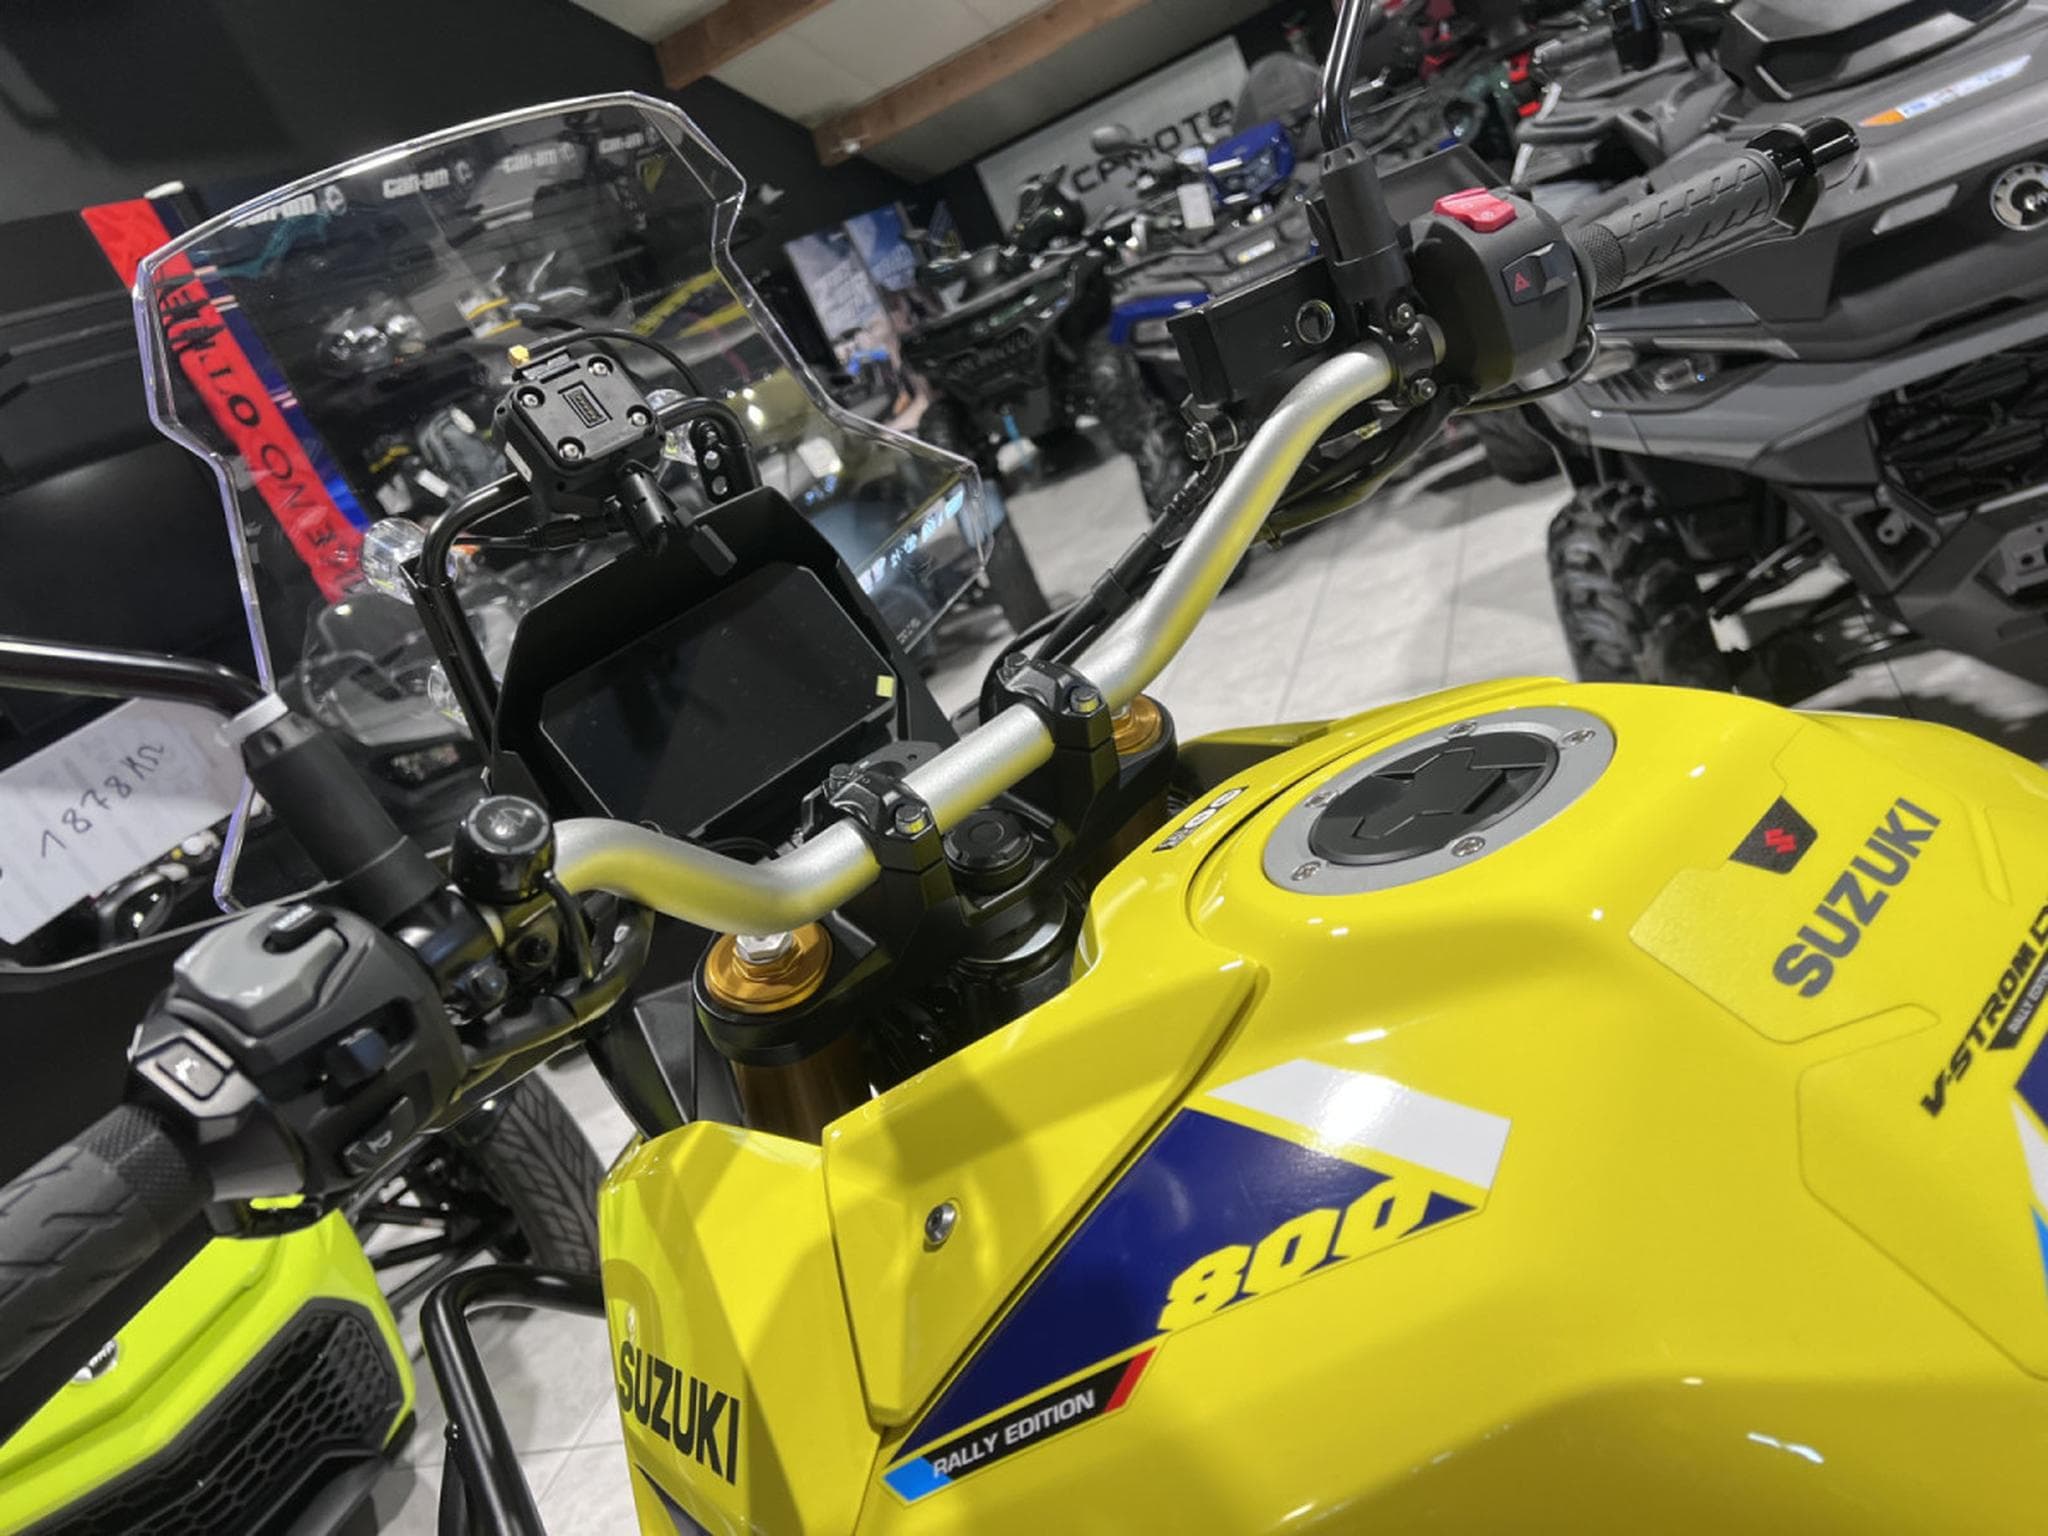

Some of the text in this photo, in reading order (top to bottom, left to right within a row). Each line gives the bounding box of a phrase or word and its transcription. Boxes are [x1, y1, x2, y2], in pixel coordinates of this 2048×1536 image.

[382, 167, 450, 200] can-am
[1772, 796, 1941, 999] SUZUKI
[1920, 941, 2038, 1118] V-STROM
[1157, 1172, 1430, 1331] 800
[619, 1340, 741, 1487] SUZUKI
[933, 1388, 1096, 1480] RALLY EDITION
